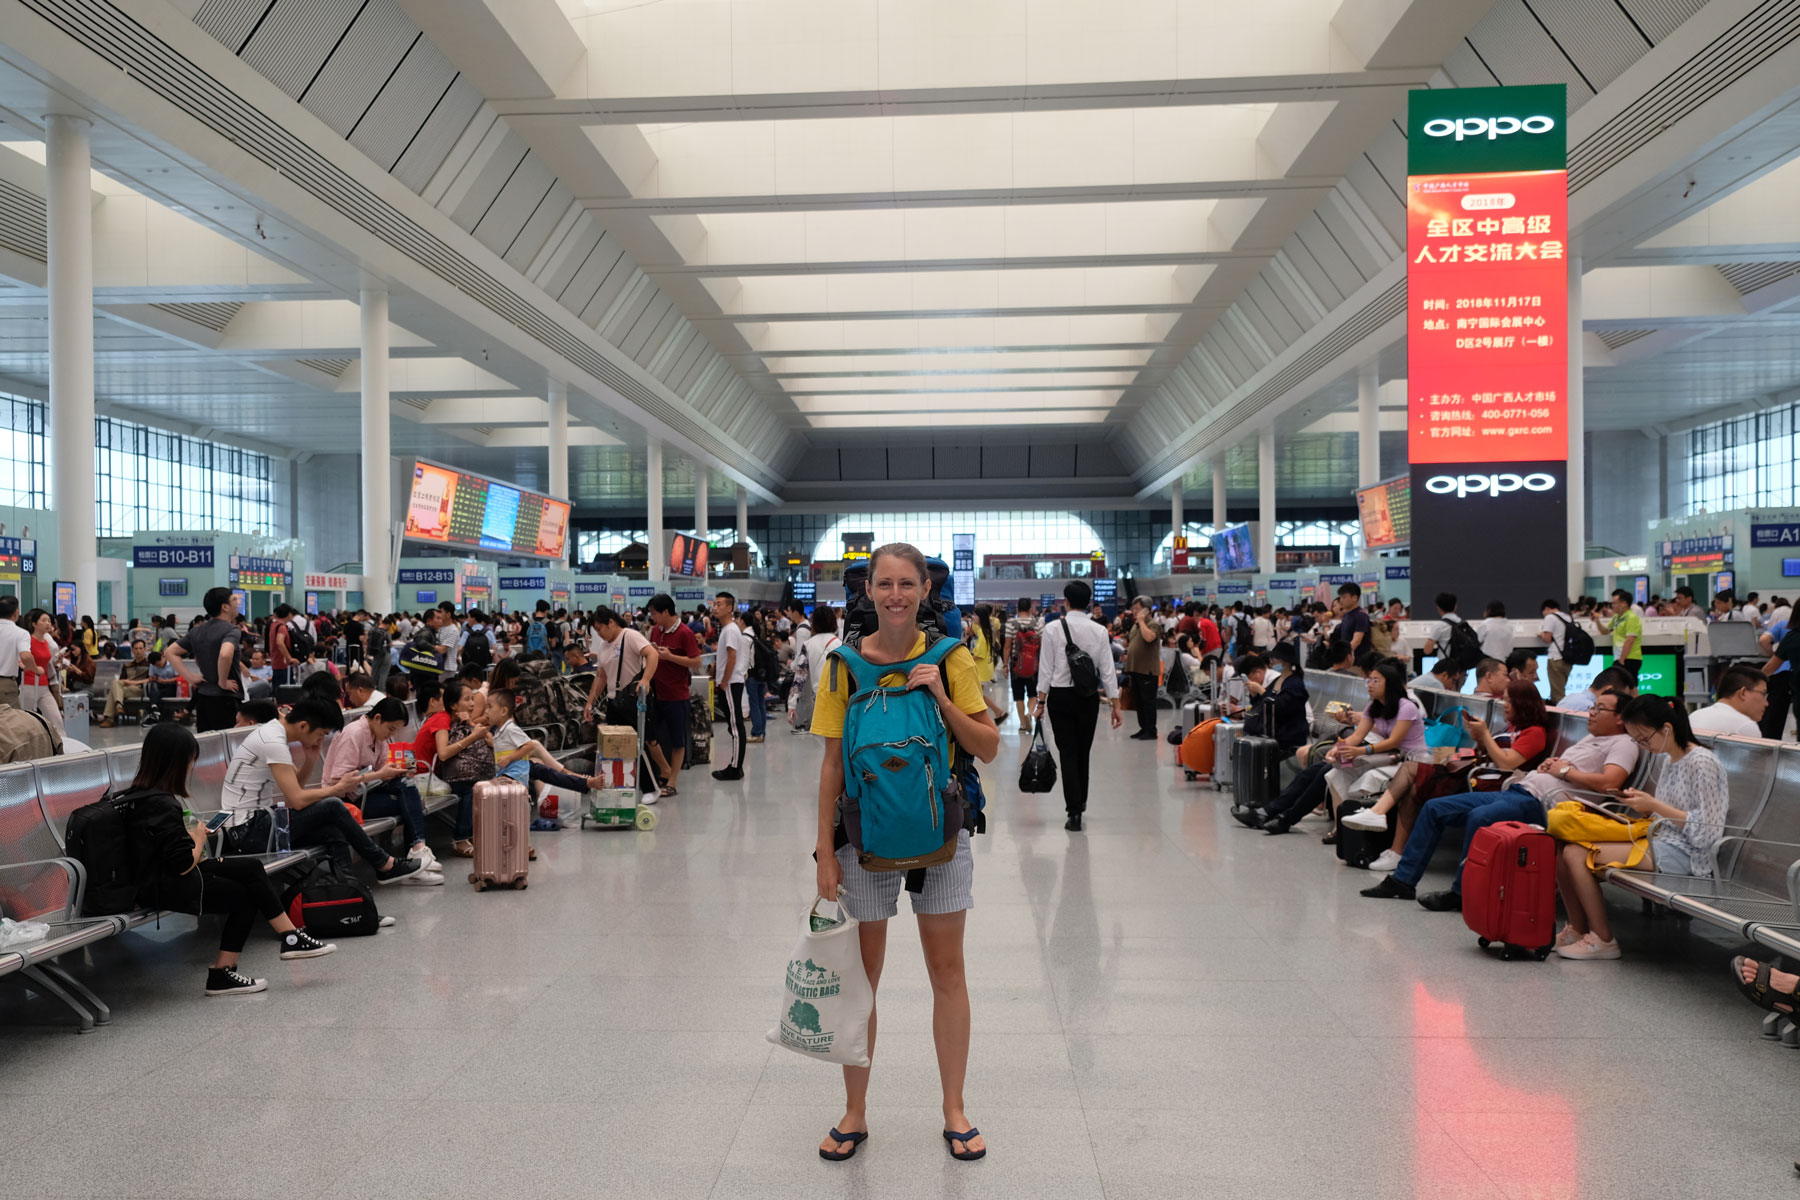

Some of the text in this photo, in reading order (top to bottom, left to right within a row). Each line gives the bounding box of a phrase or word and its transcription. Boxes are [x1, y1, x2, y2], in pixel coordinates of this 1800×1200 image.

[1470, 198, 1505, 208] 2018年
[1427, 215, 1551, 237] 全区中高级
[1414, 241, 1564, 263] 人才交流大会
[1456, 296, 1541, 309] 2018年11月17日
[1456, 315, 1546, 329] 南宁国际会展中心
[1472, 391, 1556, 404] 中国广西人才市场
[1481, 408, 1550, 419] 400-0771-056
[1481, 425, 1553, 437] www.gxrc.com
[159, 550, 212, 563] B10-B11
[23, 559, 34, 572] B9
[416, 572, 454, 581] B12-B13
[513, 579, 545, 587] B14-B15
[579, 584, 606, 592] B16-B17
[793, 982, 818, 997] PLASTIC
[819, 984, 840, 997] BAGS
[796, 1034, 835, 1045] NATURE
